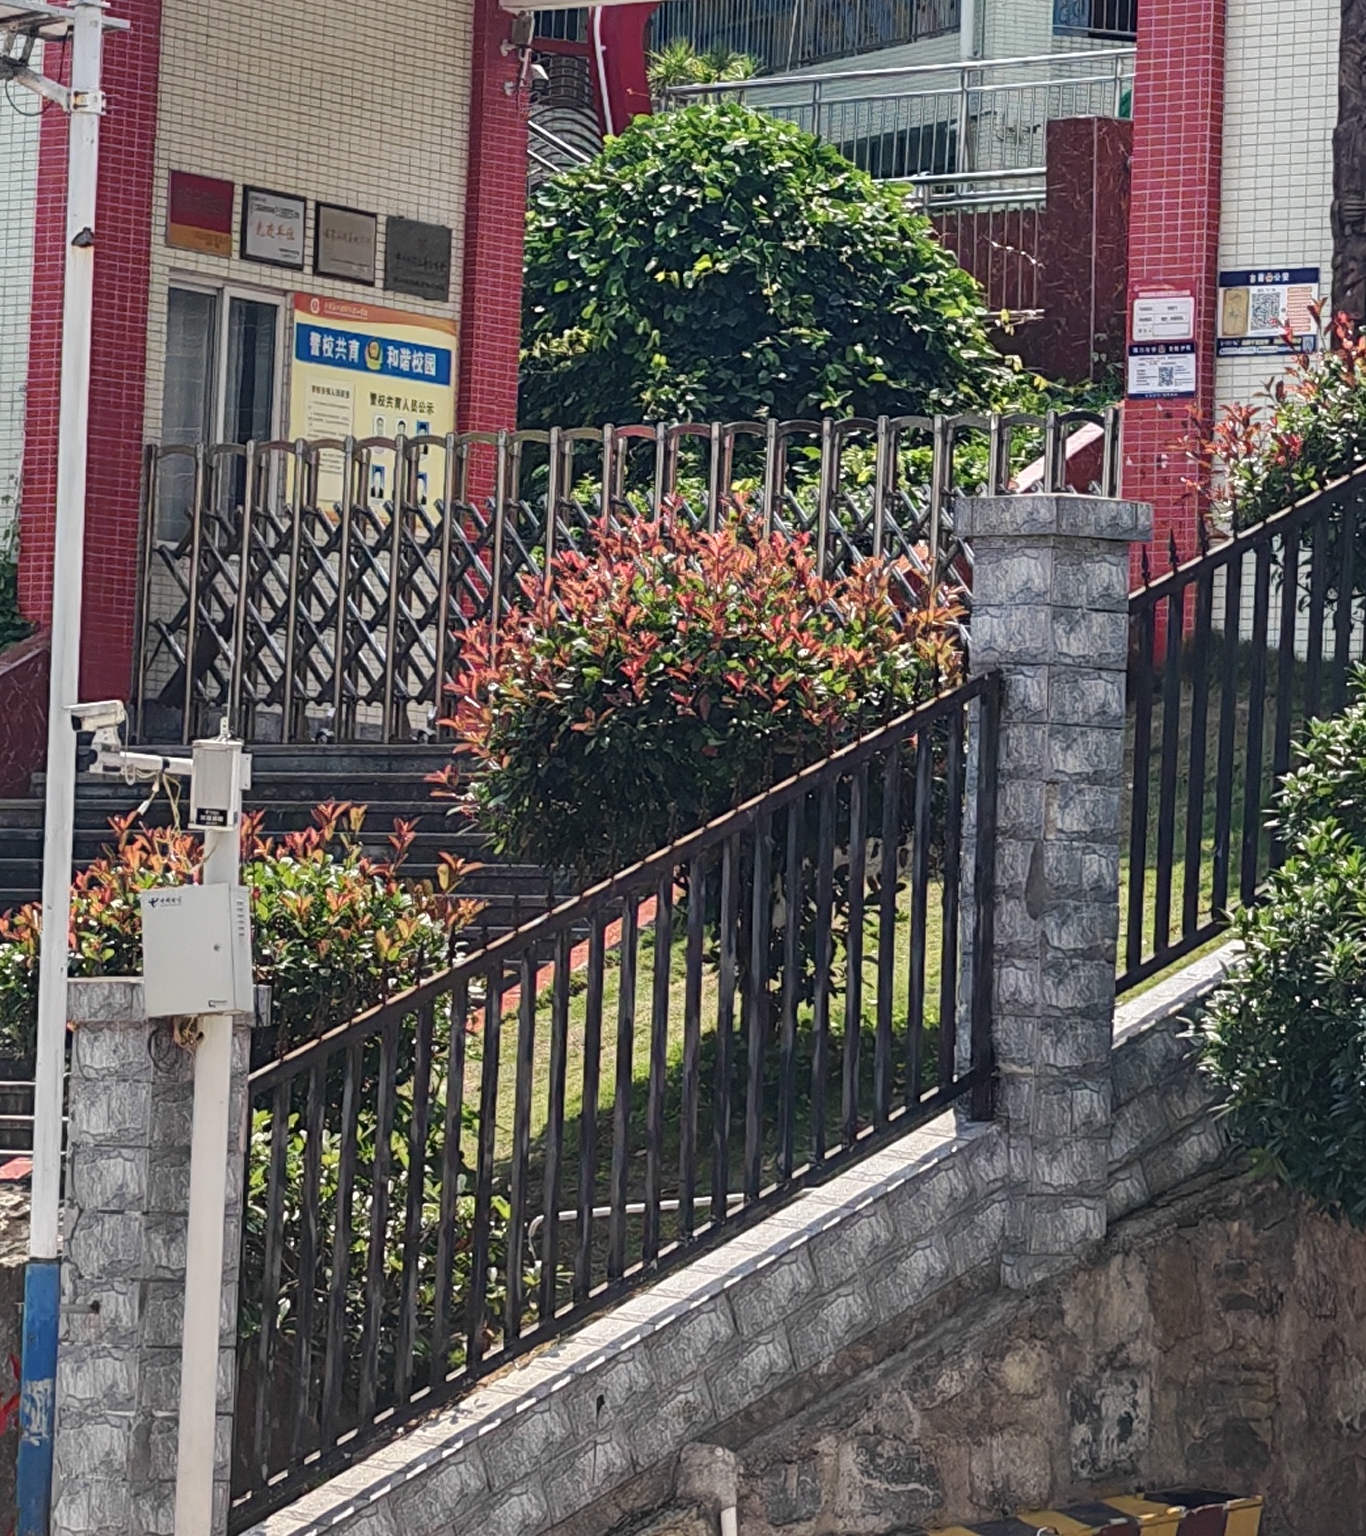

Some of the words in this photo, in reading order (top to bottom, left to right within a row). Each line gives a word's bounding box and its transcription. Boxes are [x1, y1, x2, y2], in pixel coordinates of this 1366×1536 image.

[309, 332, 360, 363] 警校共育
[386, 346, 436, 377] 和谐校园
